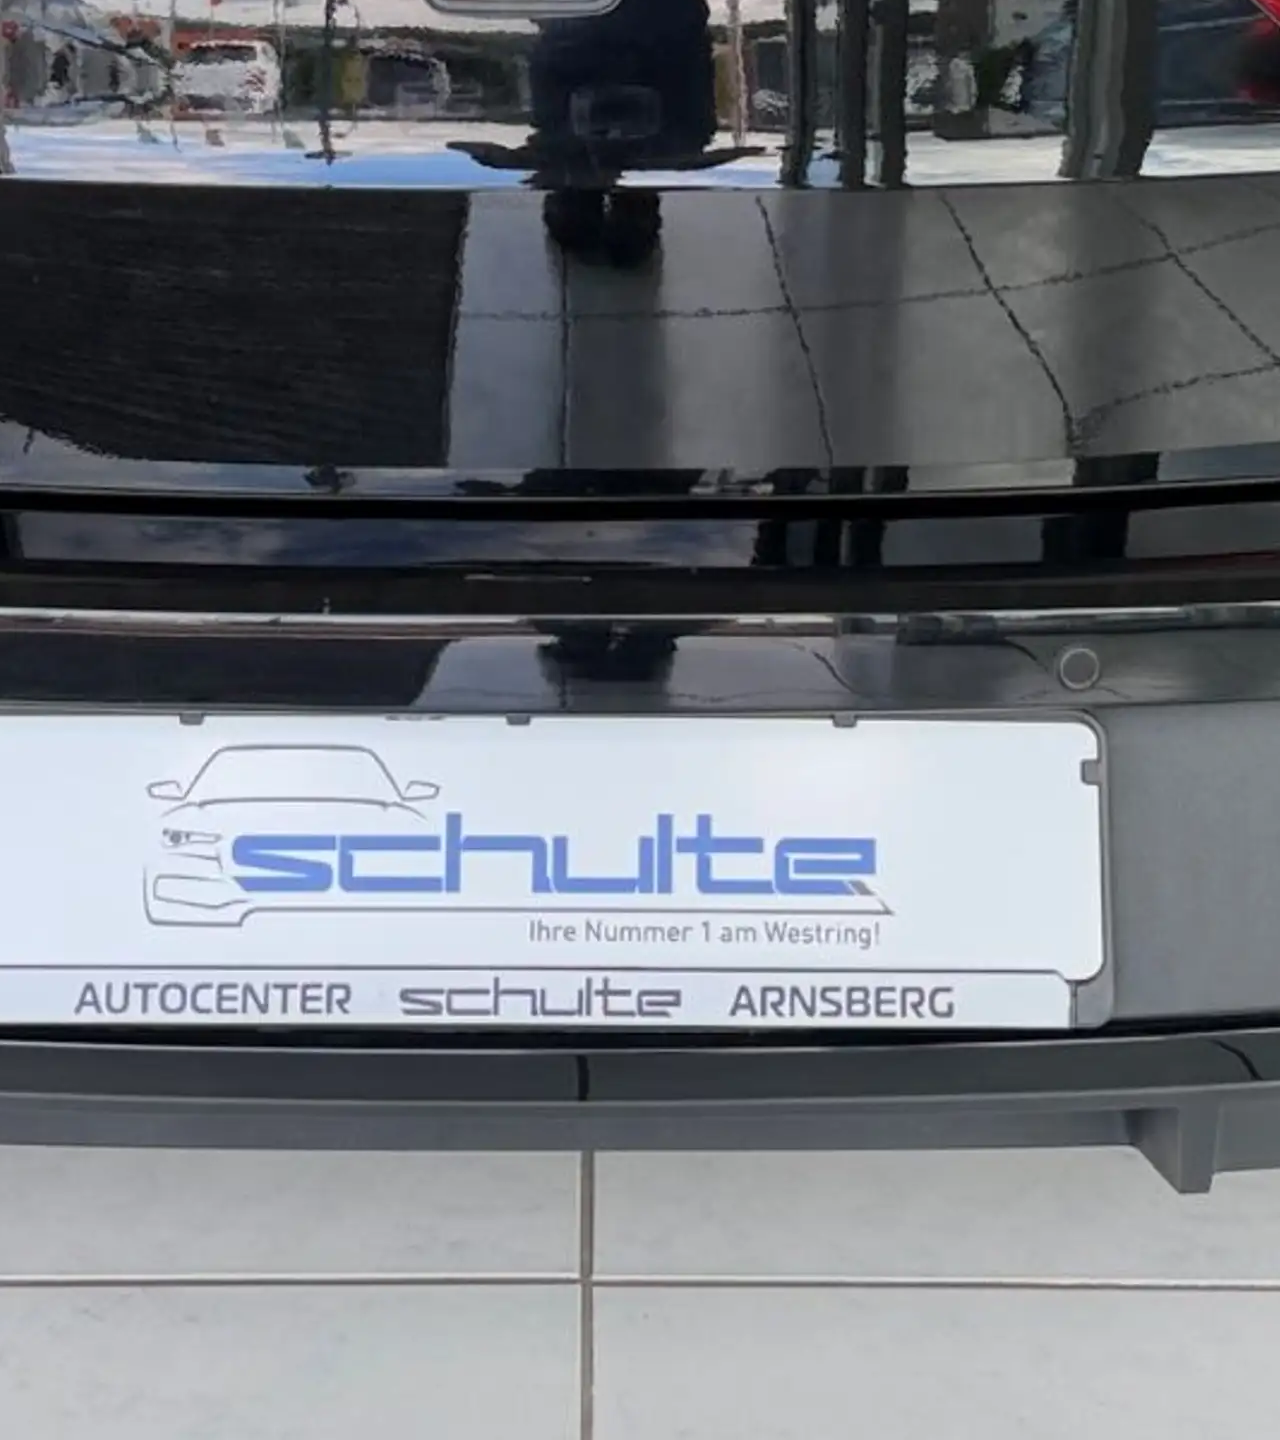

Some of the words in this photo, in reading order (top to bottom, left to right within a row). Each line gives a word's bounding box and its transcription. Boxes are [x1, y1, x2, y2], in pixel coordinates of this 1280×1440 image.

[231, 812, 878, 896] schulte
[528, 919, 578, 943] Ihre
[583, 921, 693, 944] Nummer
[700, 921, 711, 944] 1
[719, 926, 758, 945] am
[764, 922, 882, 949] Westring!
[73, 981, 353, 1019] AUTOCENTER
[399, 976, 682, 1019] schulte
[729, 984, 956, 1020] ARNSBERG
